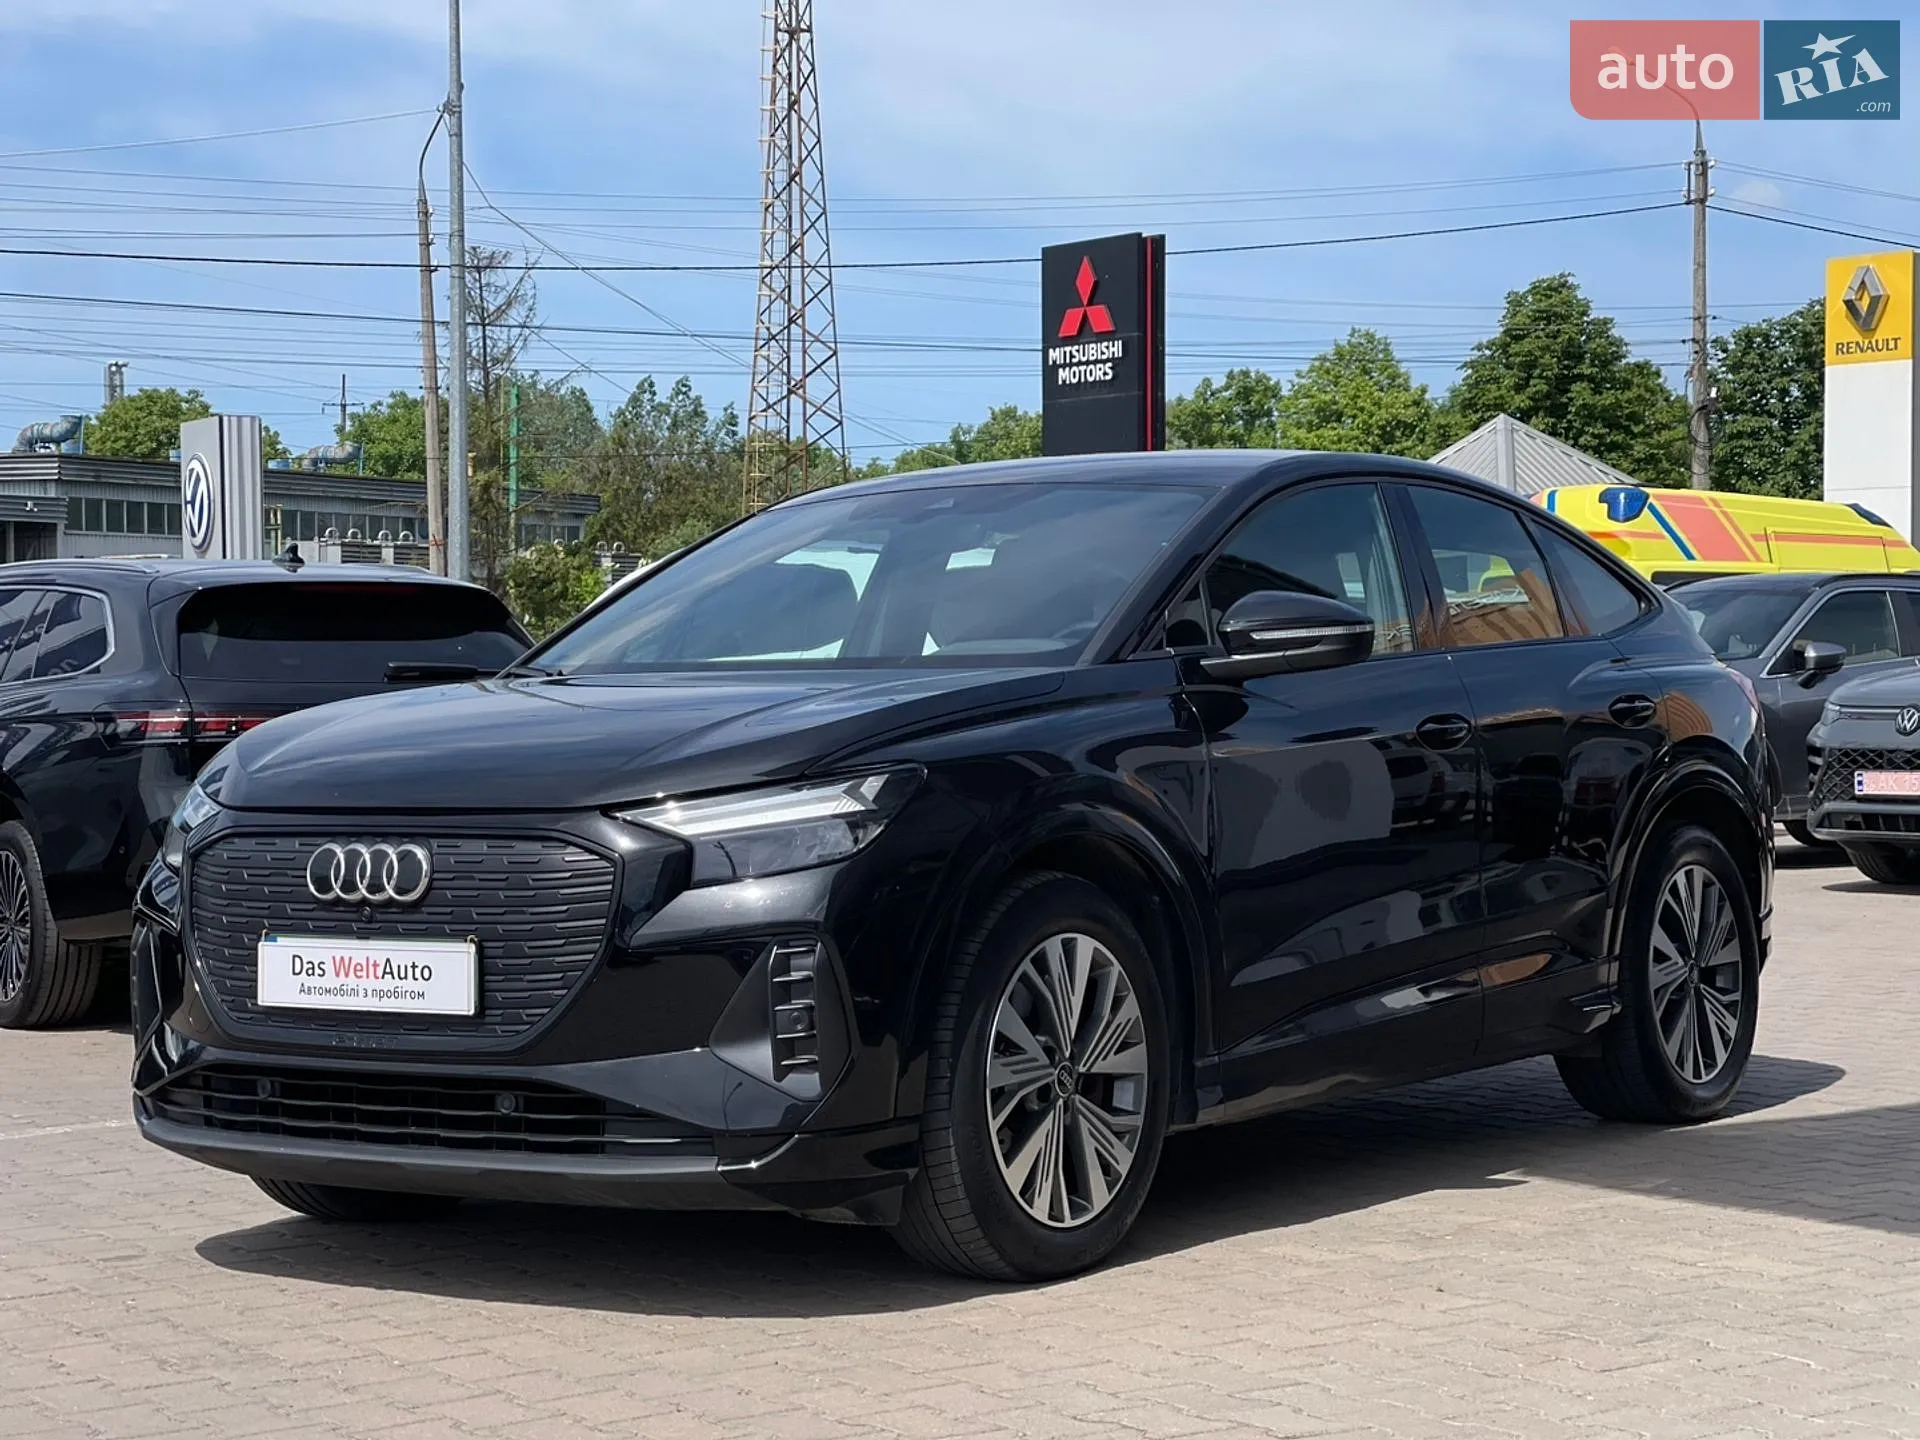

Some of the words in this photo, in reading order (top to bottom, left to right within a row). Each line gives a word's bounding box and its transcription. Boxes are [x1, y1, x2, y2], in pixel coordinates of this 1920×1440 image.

[1048, 339, 1123, 366] MITSUBISHI
[1835, 336, 1902, 356] RENAULT
[1057, 362, 1113, 386] MOTORS
[291, 954, 326, 979] Das
[332, 955, 433, 982] WeltAuto
[298, 982, 360, 998] Автомобілі
[362, 987, 368, 998] з
[371, 986, 425, 1001] пробігом
